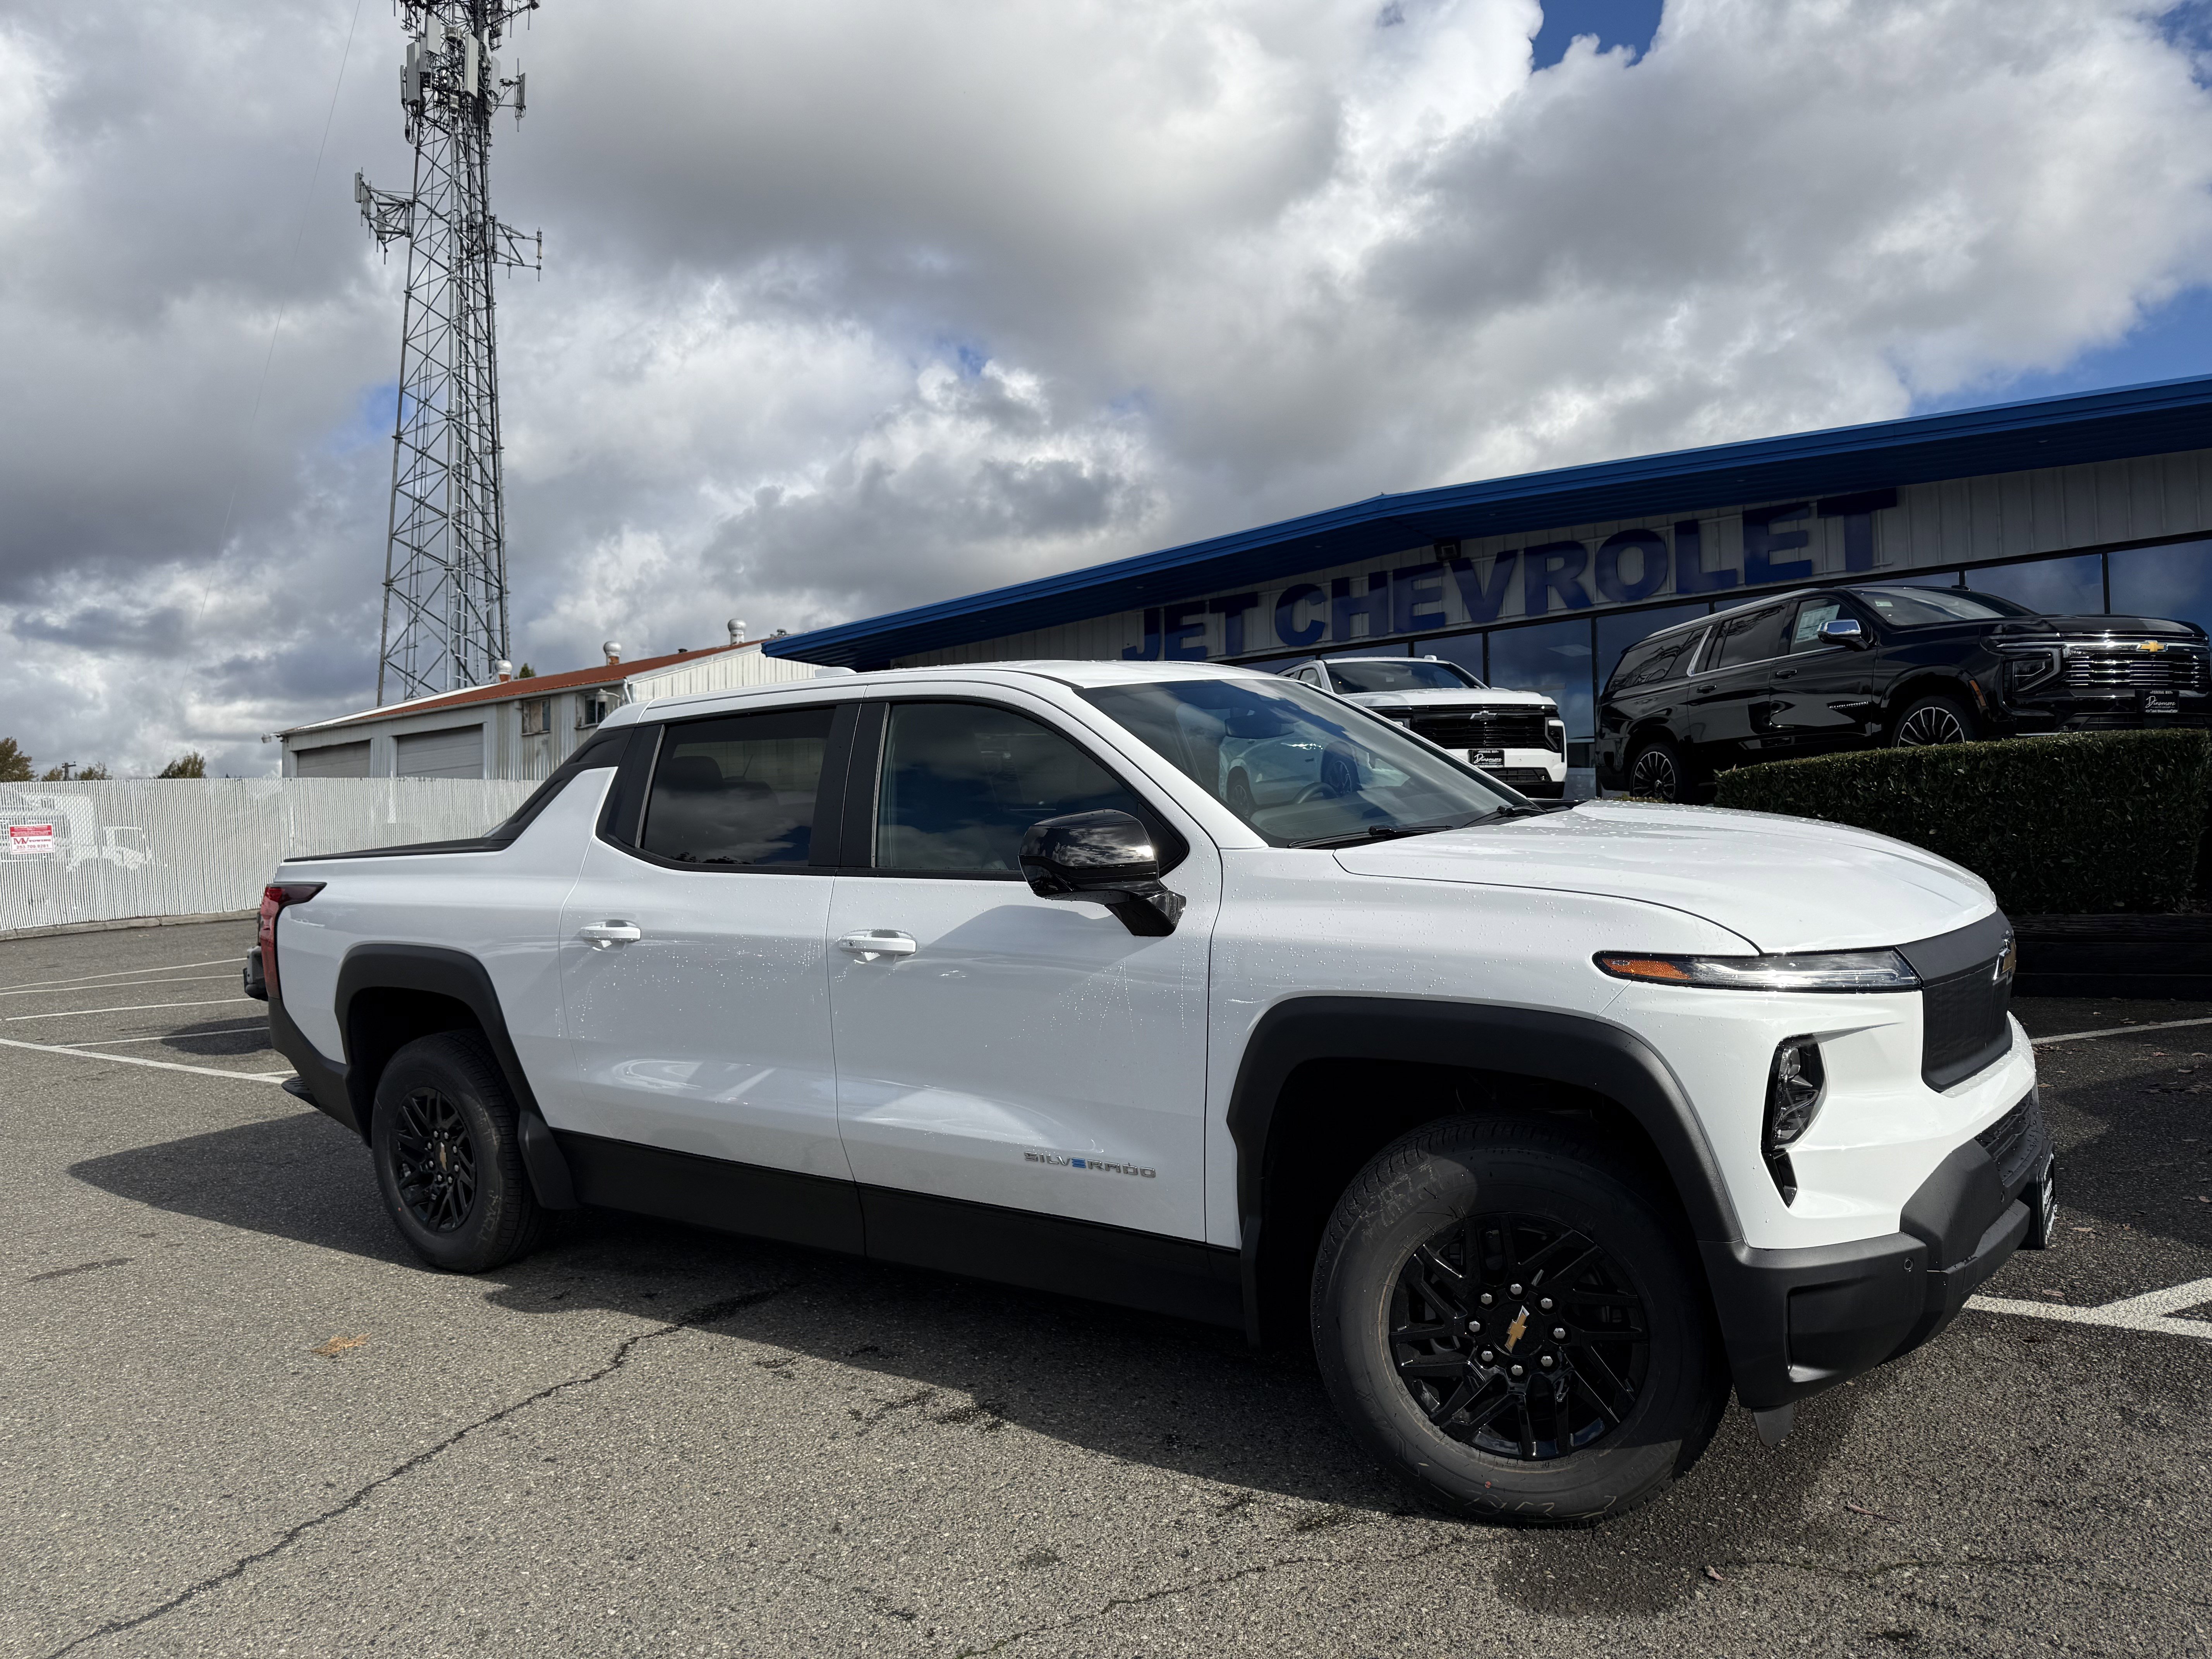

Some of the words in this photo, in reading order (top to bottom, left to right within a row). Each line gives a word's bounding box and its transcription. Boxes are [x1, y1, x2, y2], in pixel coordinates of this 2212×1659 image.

[1122, 592, 1258, 661] JET
[1275, 487, 1897, 647] CHEVROLET
[2145, 696, 2176, 708] Dinsmore
[1024, 1151, 1156, 1178] SILVERADO
